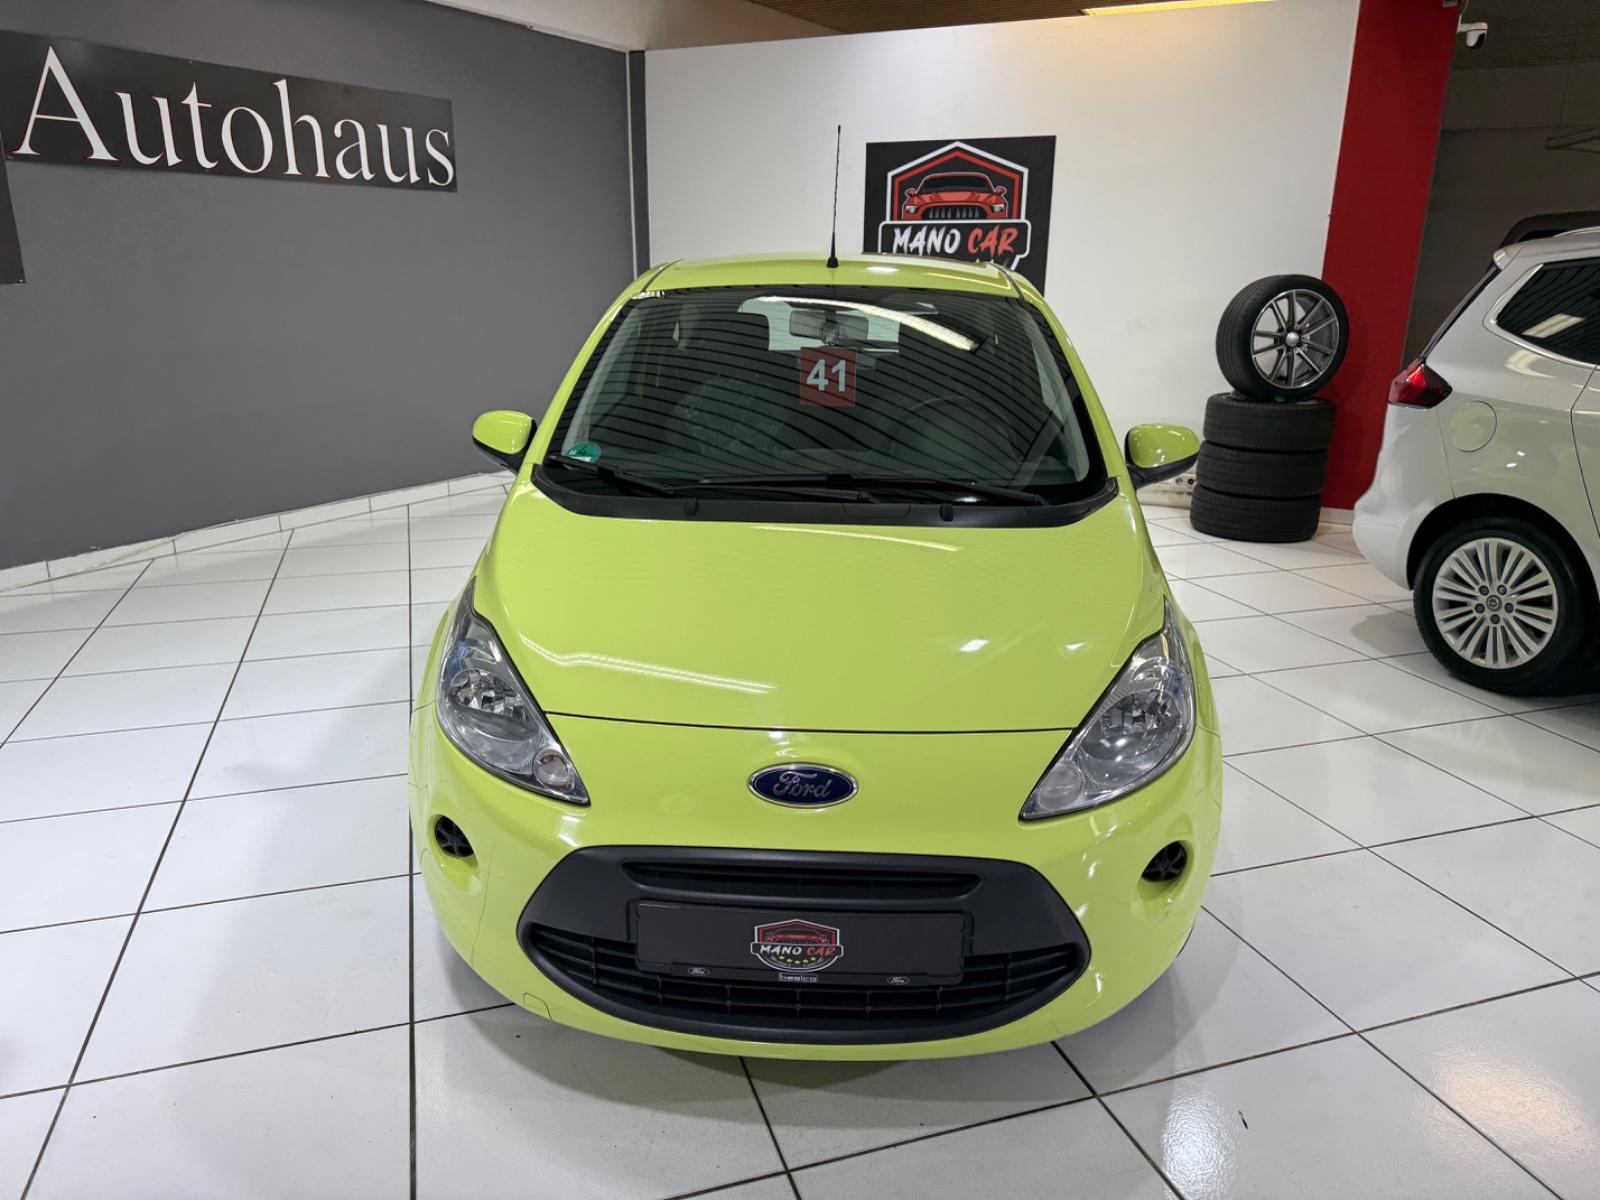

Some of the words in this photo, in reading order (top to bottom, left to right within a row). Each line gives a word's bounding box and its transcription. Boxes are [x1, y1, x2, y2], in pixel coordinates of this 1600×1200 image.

[13, 46, 455, 186] Autohaus
[892, 226, 961, 256] MANO
[967, 225, 1019, 257] CAR
[806, 359, 846, 392] 41
[773, 771, 832, 798] Ford
[760, 945, 802, 956] MANO
[806, 947, 837, 957] CAR
